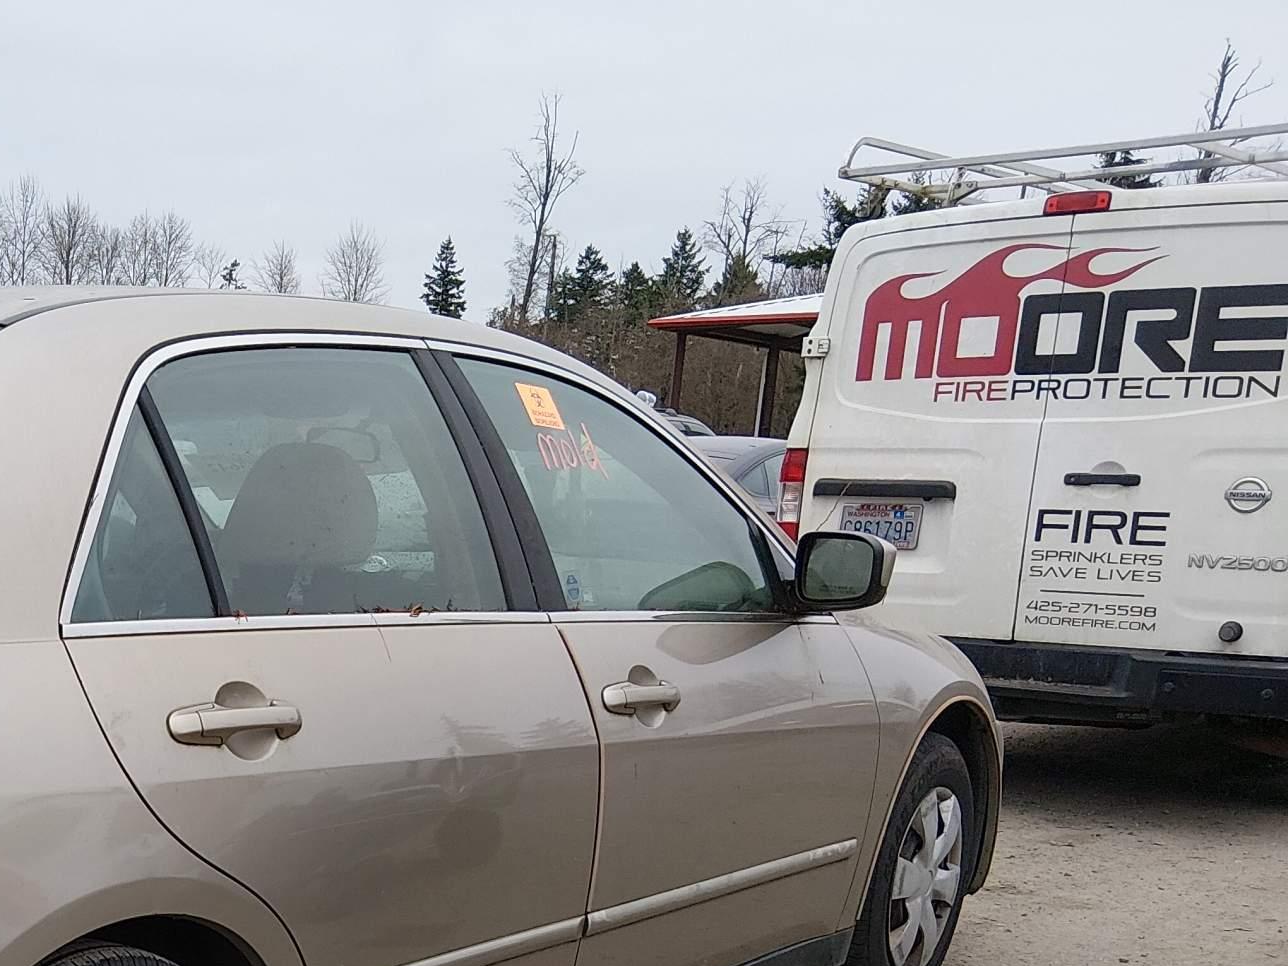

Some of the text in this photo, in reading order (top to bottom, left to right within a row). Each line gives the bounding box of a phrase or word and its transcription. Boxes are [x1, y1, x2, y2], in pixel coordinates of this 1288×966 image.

[855, 280, 1288, 382] MOORE
[1228, 491, 1267, 499] NISSAN
[847, 510, 891, 518] WASHINGTON
[1034, 508, 1171, 547] FIRE
[1030, 549, 1163, 567] SPRINKLERS
[1187, 553, 1288, 573] NV2500
[1028, 565, 1162, 583] SAVE LIVES
[1025, 600, 1158, 618] 425-271-5598
[1024, 615, 1157, 632] MOOREFIRE.COM
